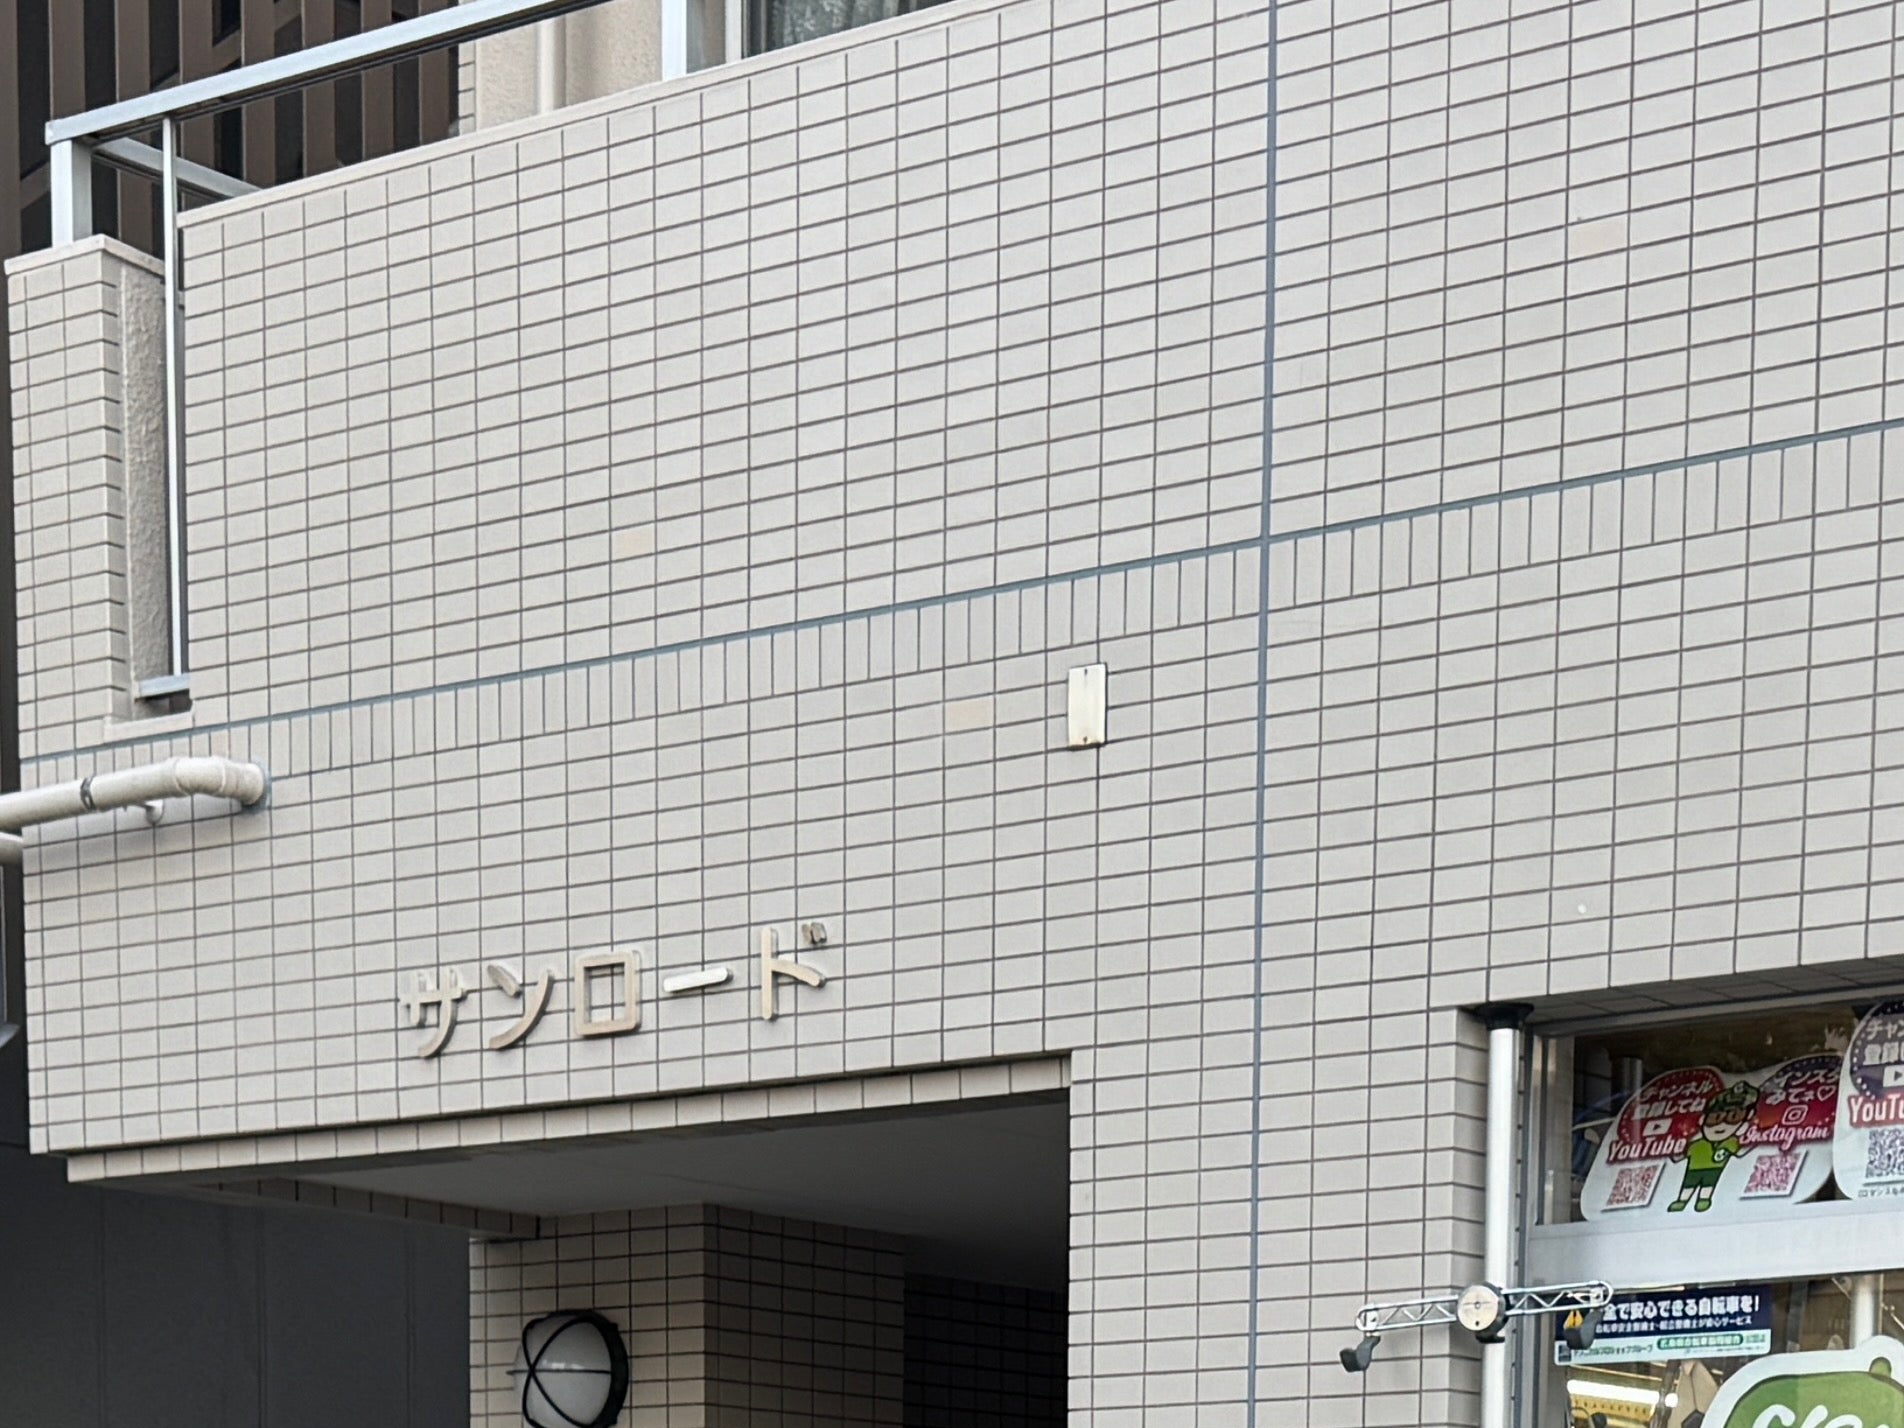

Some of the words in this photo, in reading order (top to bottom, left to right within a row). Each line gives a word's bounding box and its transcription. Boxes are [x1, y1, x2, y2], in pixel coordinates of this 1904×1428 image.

[400, 920, 828, 1058] サンロード
[1608, 1136, 1687, 1162] YouTube
[1739, 1124, 1829, 1151] Instagram
[1602, 1295, 1760, 1322] 全で安心できる自転車を!
